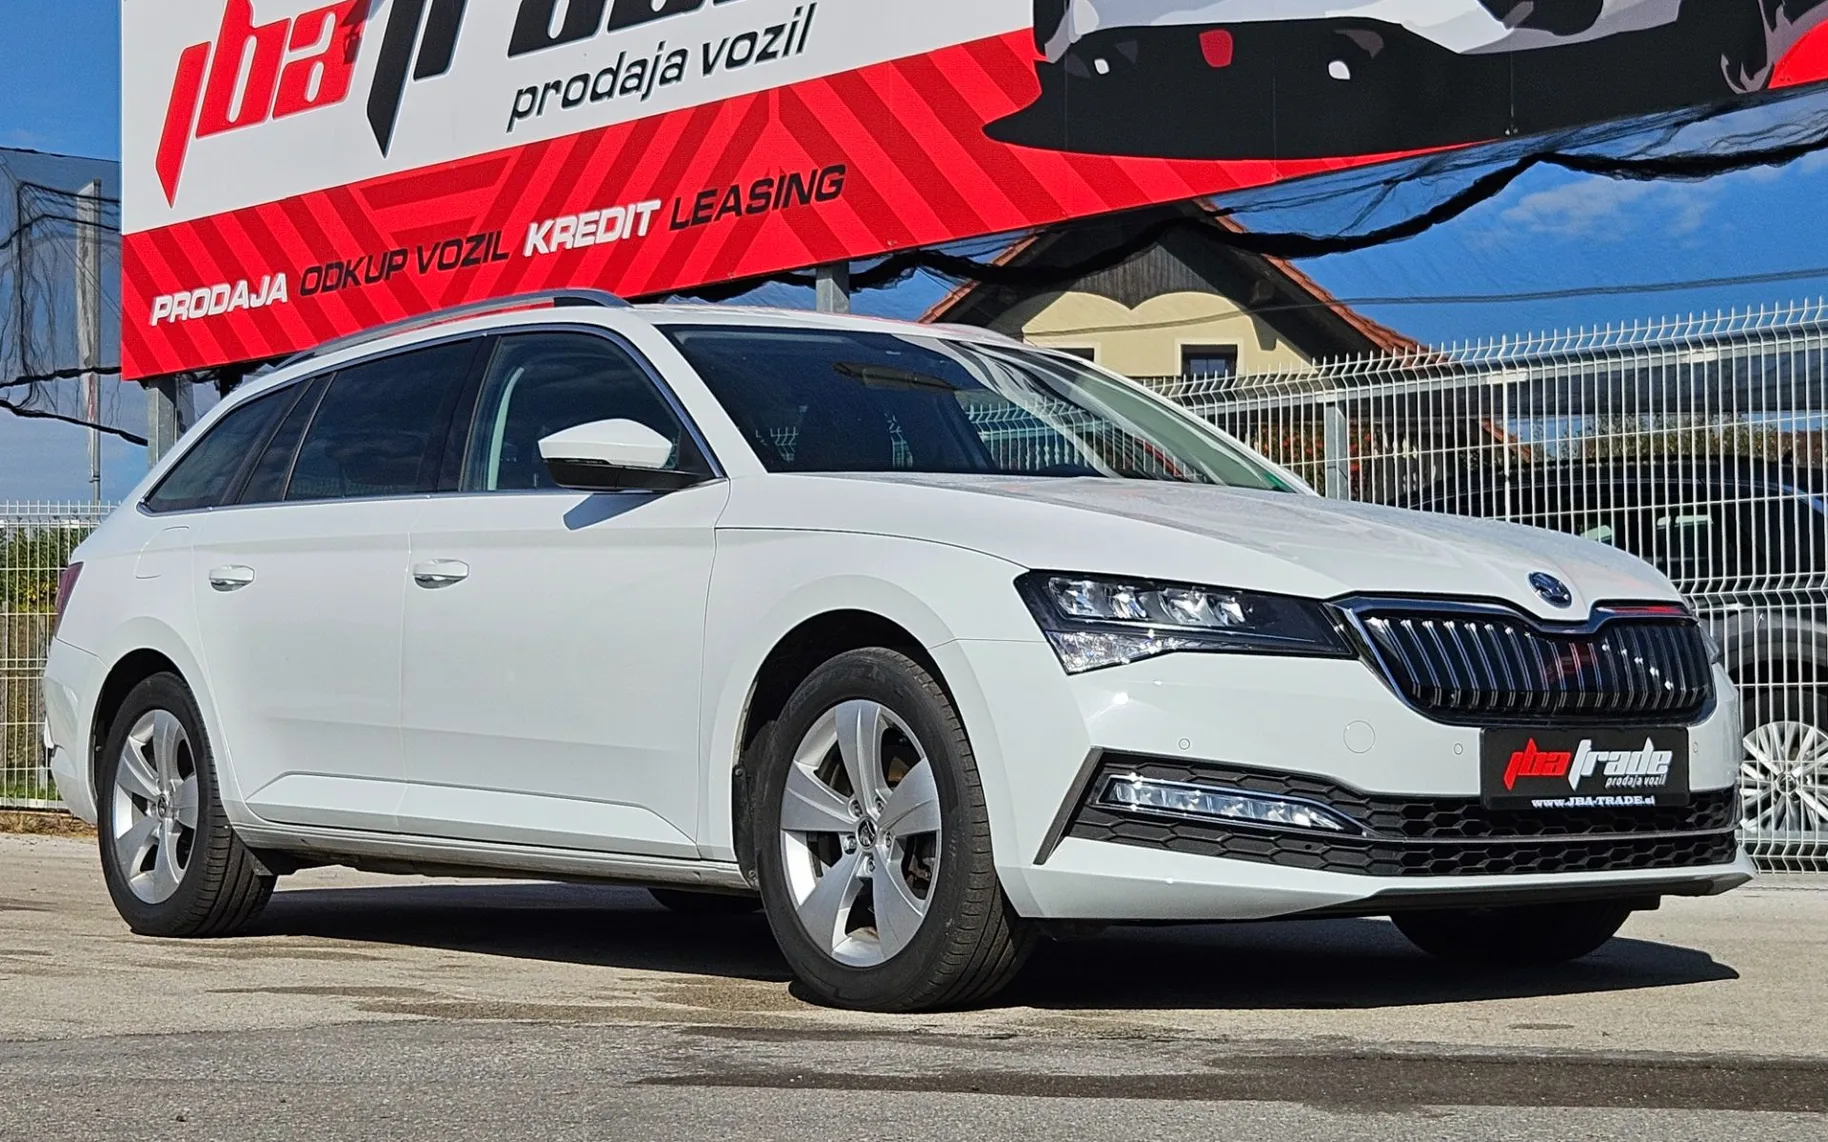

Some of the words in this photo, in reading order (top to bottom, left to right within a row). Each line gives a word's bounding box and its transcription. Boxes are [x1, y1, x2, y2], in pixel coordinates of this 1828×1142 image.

[506, 40, 689, 133] prodaja
[702, 2, 818, 77] vozil
[149, 272, 288, 327] PRODAJA
[299, 248, 409, 297] ODKUP
[417, 230, 510, 275] VOZIL
[523, 199, 661, 258] KREDIT
[669, 164, 847, 231] LEASING
[1605, 774, 1642, 788] prodaja
[1644, 774, 1667, 786] vozil
